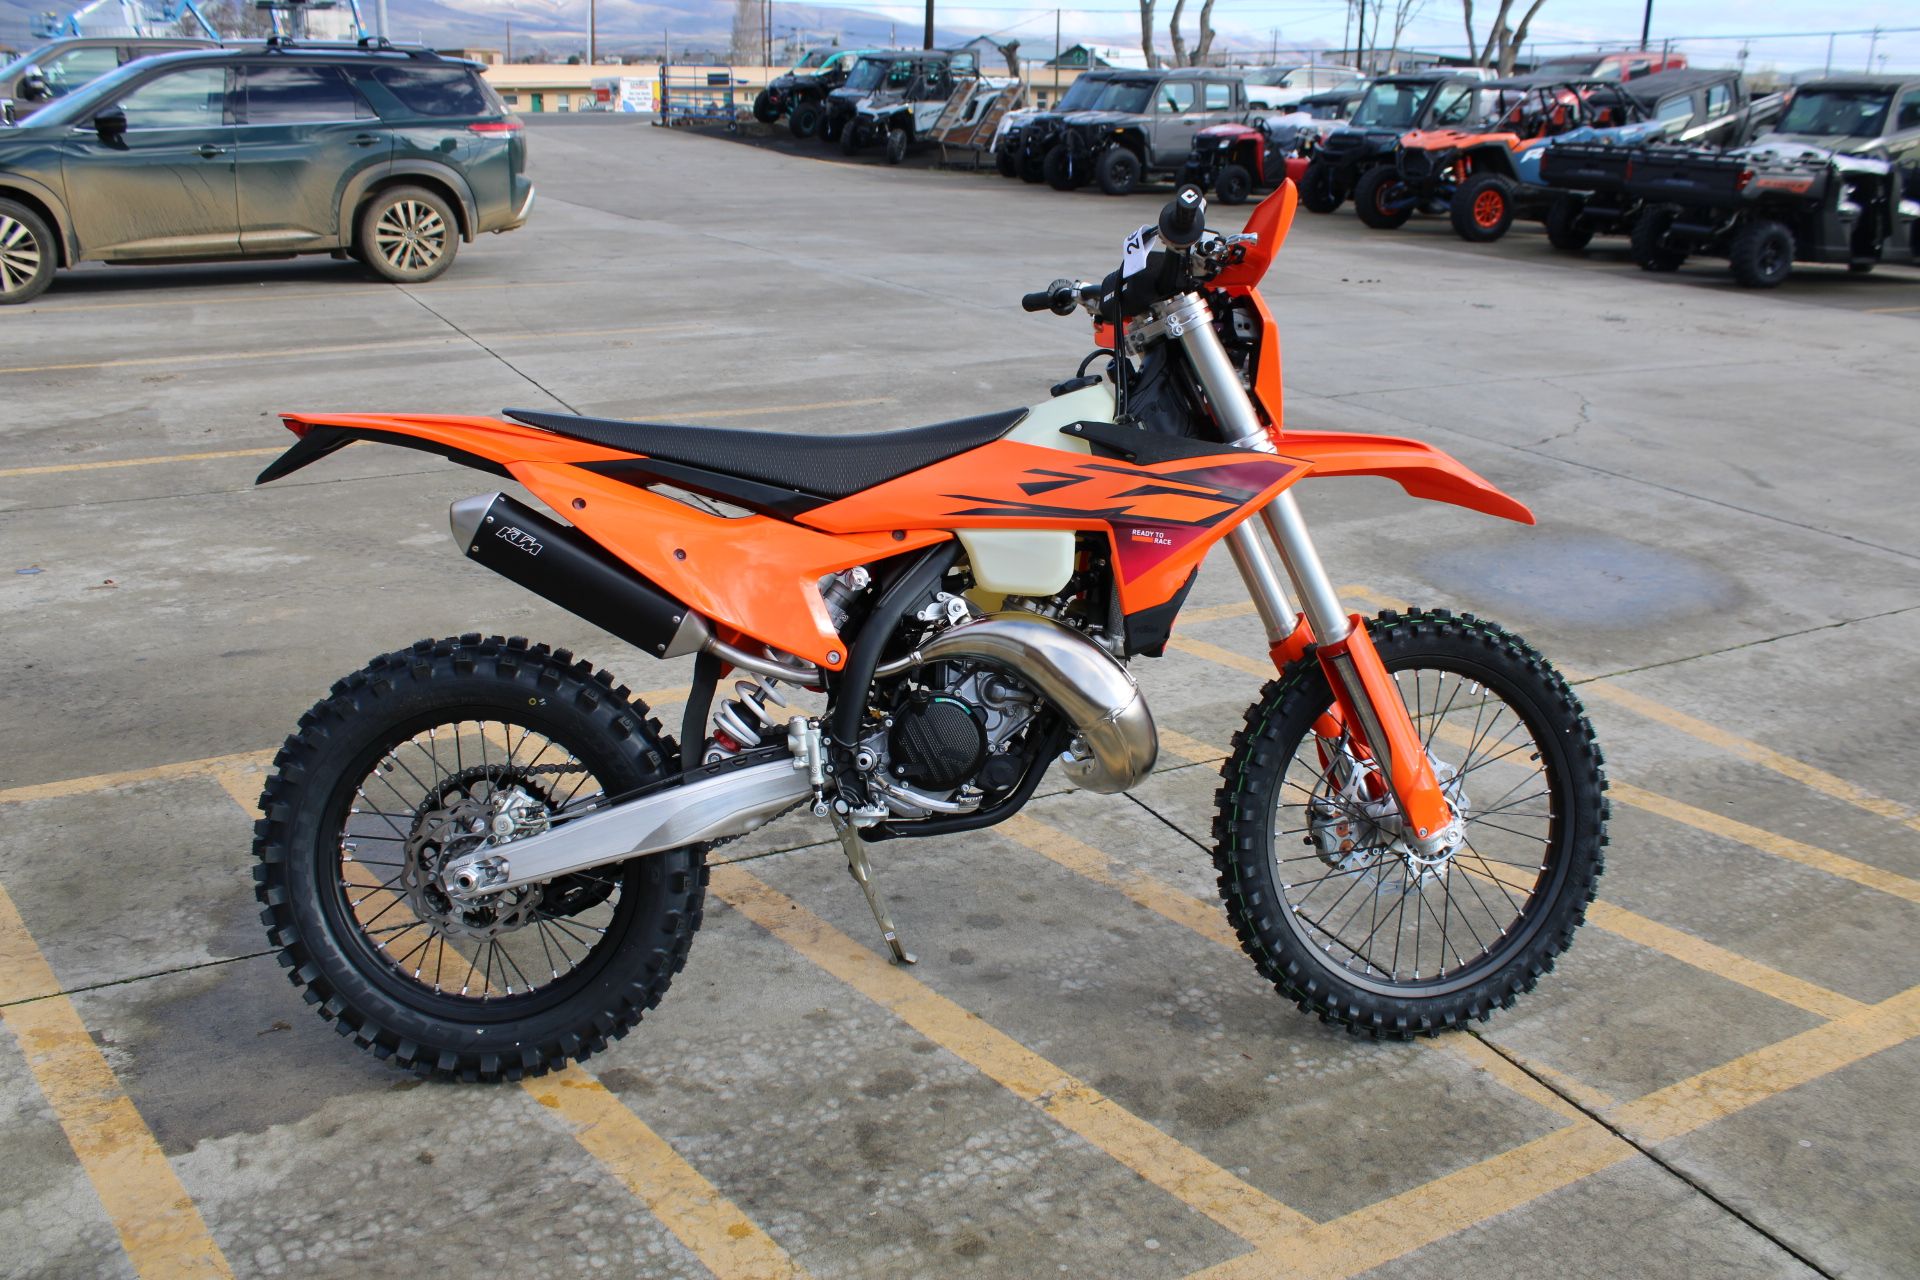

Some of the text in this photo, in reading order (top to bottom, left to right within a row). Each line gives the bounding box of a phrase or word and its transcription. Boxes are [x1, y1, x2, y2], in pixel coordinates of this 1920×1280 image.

[1132, 529, 1154, 537] READY
[495, 526, 544, 556] KTM
[1154, 538, 1172, 546] RACE
